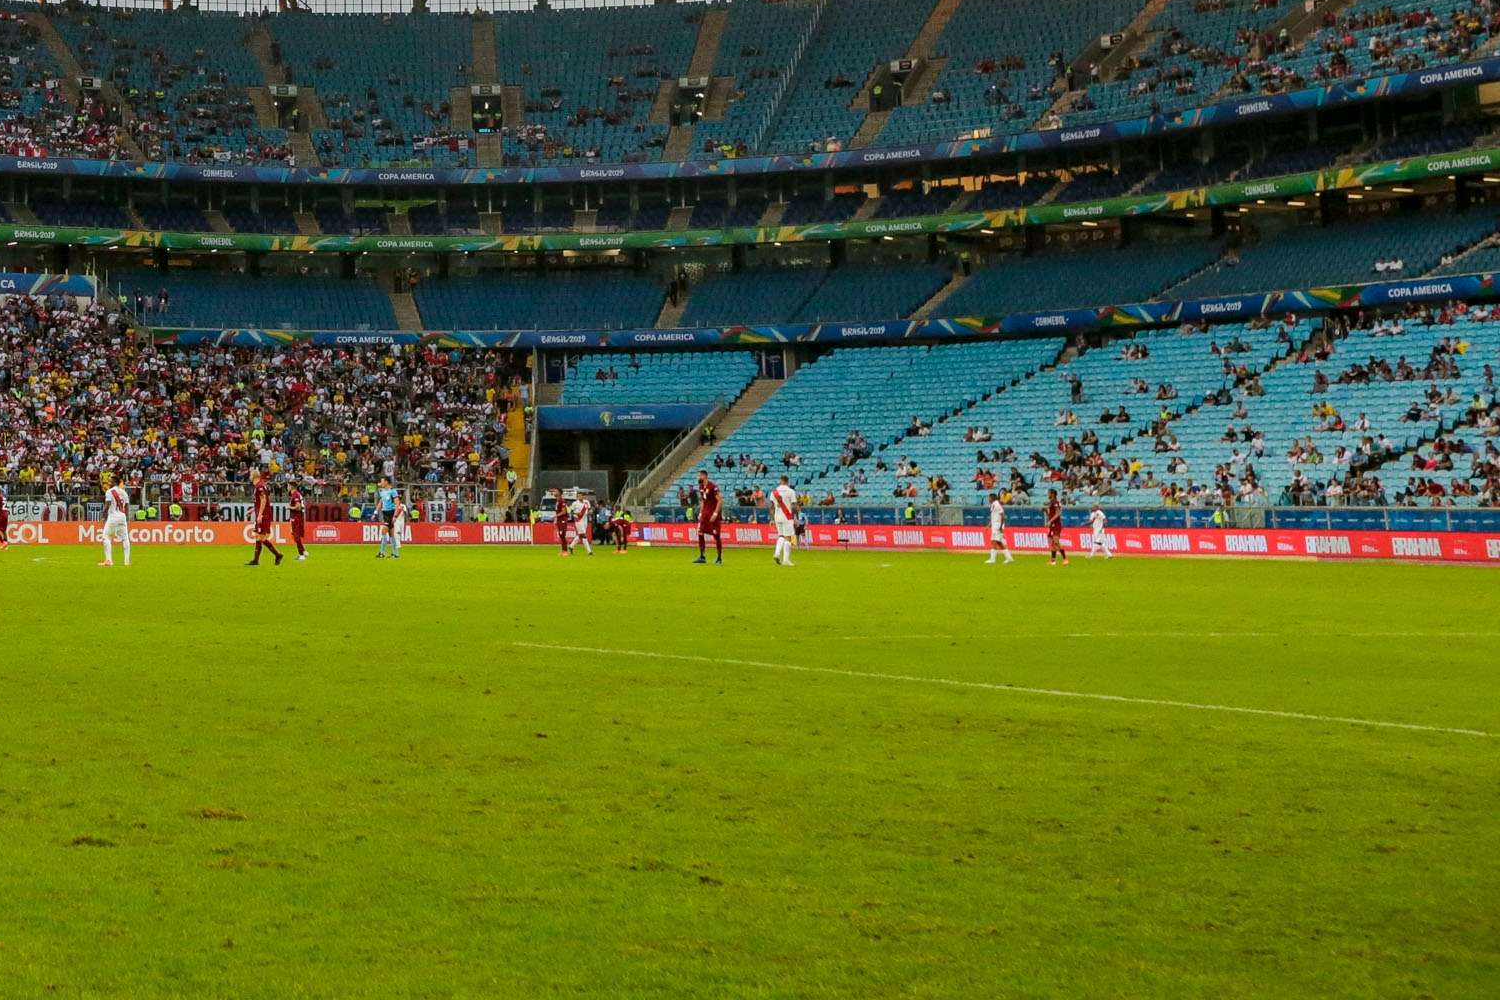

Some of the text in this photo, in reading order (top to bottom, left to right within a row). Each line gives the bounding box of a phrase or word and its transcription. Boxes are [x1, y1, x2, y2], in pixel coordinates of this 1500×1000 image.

[1419, 66, 1483, 85] COPA AMERICA
[1238, 102, 1270, 115] CONMEBOL
[863, 150, 920, 162] COPA AMERICA
[1427, 155, 1491, 172] COPA AMERICA
[202, 169, 235, 178] CONMEBOL
[378, 173, 435, 181] COPA AMERICA
[865, 222, 922, 234] COPA AMERICA
[200, 237, 233, 246] CONMEBOL
[377, 240, 433, 248] COPA AMERICA
[1388, 284, 1453, 298] COPA AMERICA
[336, 335, 358, 344] COPA
[634, 332, 695, 342] COPA AMERICA
[6, 523, 49, 544] GOL
[129, 525, 214, 543] conforto
[243, 524, 286, 544] GL
[316, 529, 337, 538] BRAHMA
[437, 530, 459, 538] BRAHMA
[483, 525, 532, 543] BRAHMA
[893, 530, 924, 545] BRAHMA
[952, 531, 985, 547] BRAHMA
[1013, 532, 1049, 548] BRAHMA
[1150, 534, 1190, 551] BRAHMA
[1225, 535, 1268, 552] BRAHMA
[1305, 535, 1352, 554] BRAHMA
[1392, 537, 1442, 557] BRAHMA
